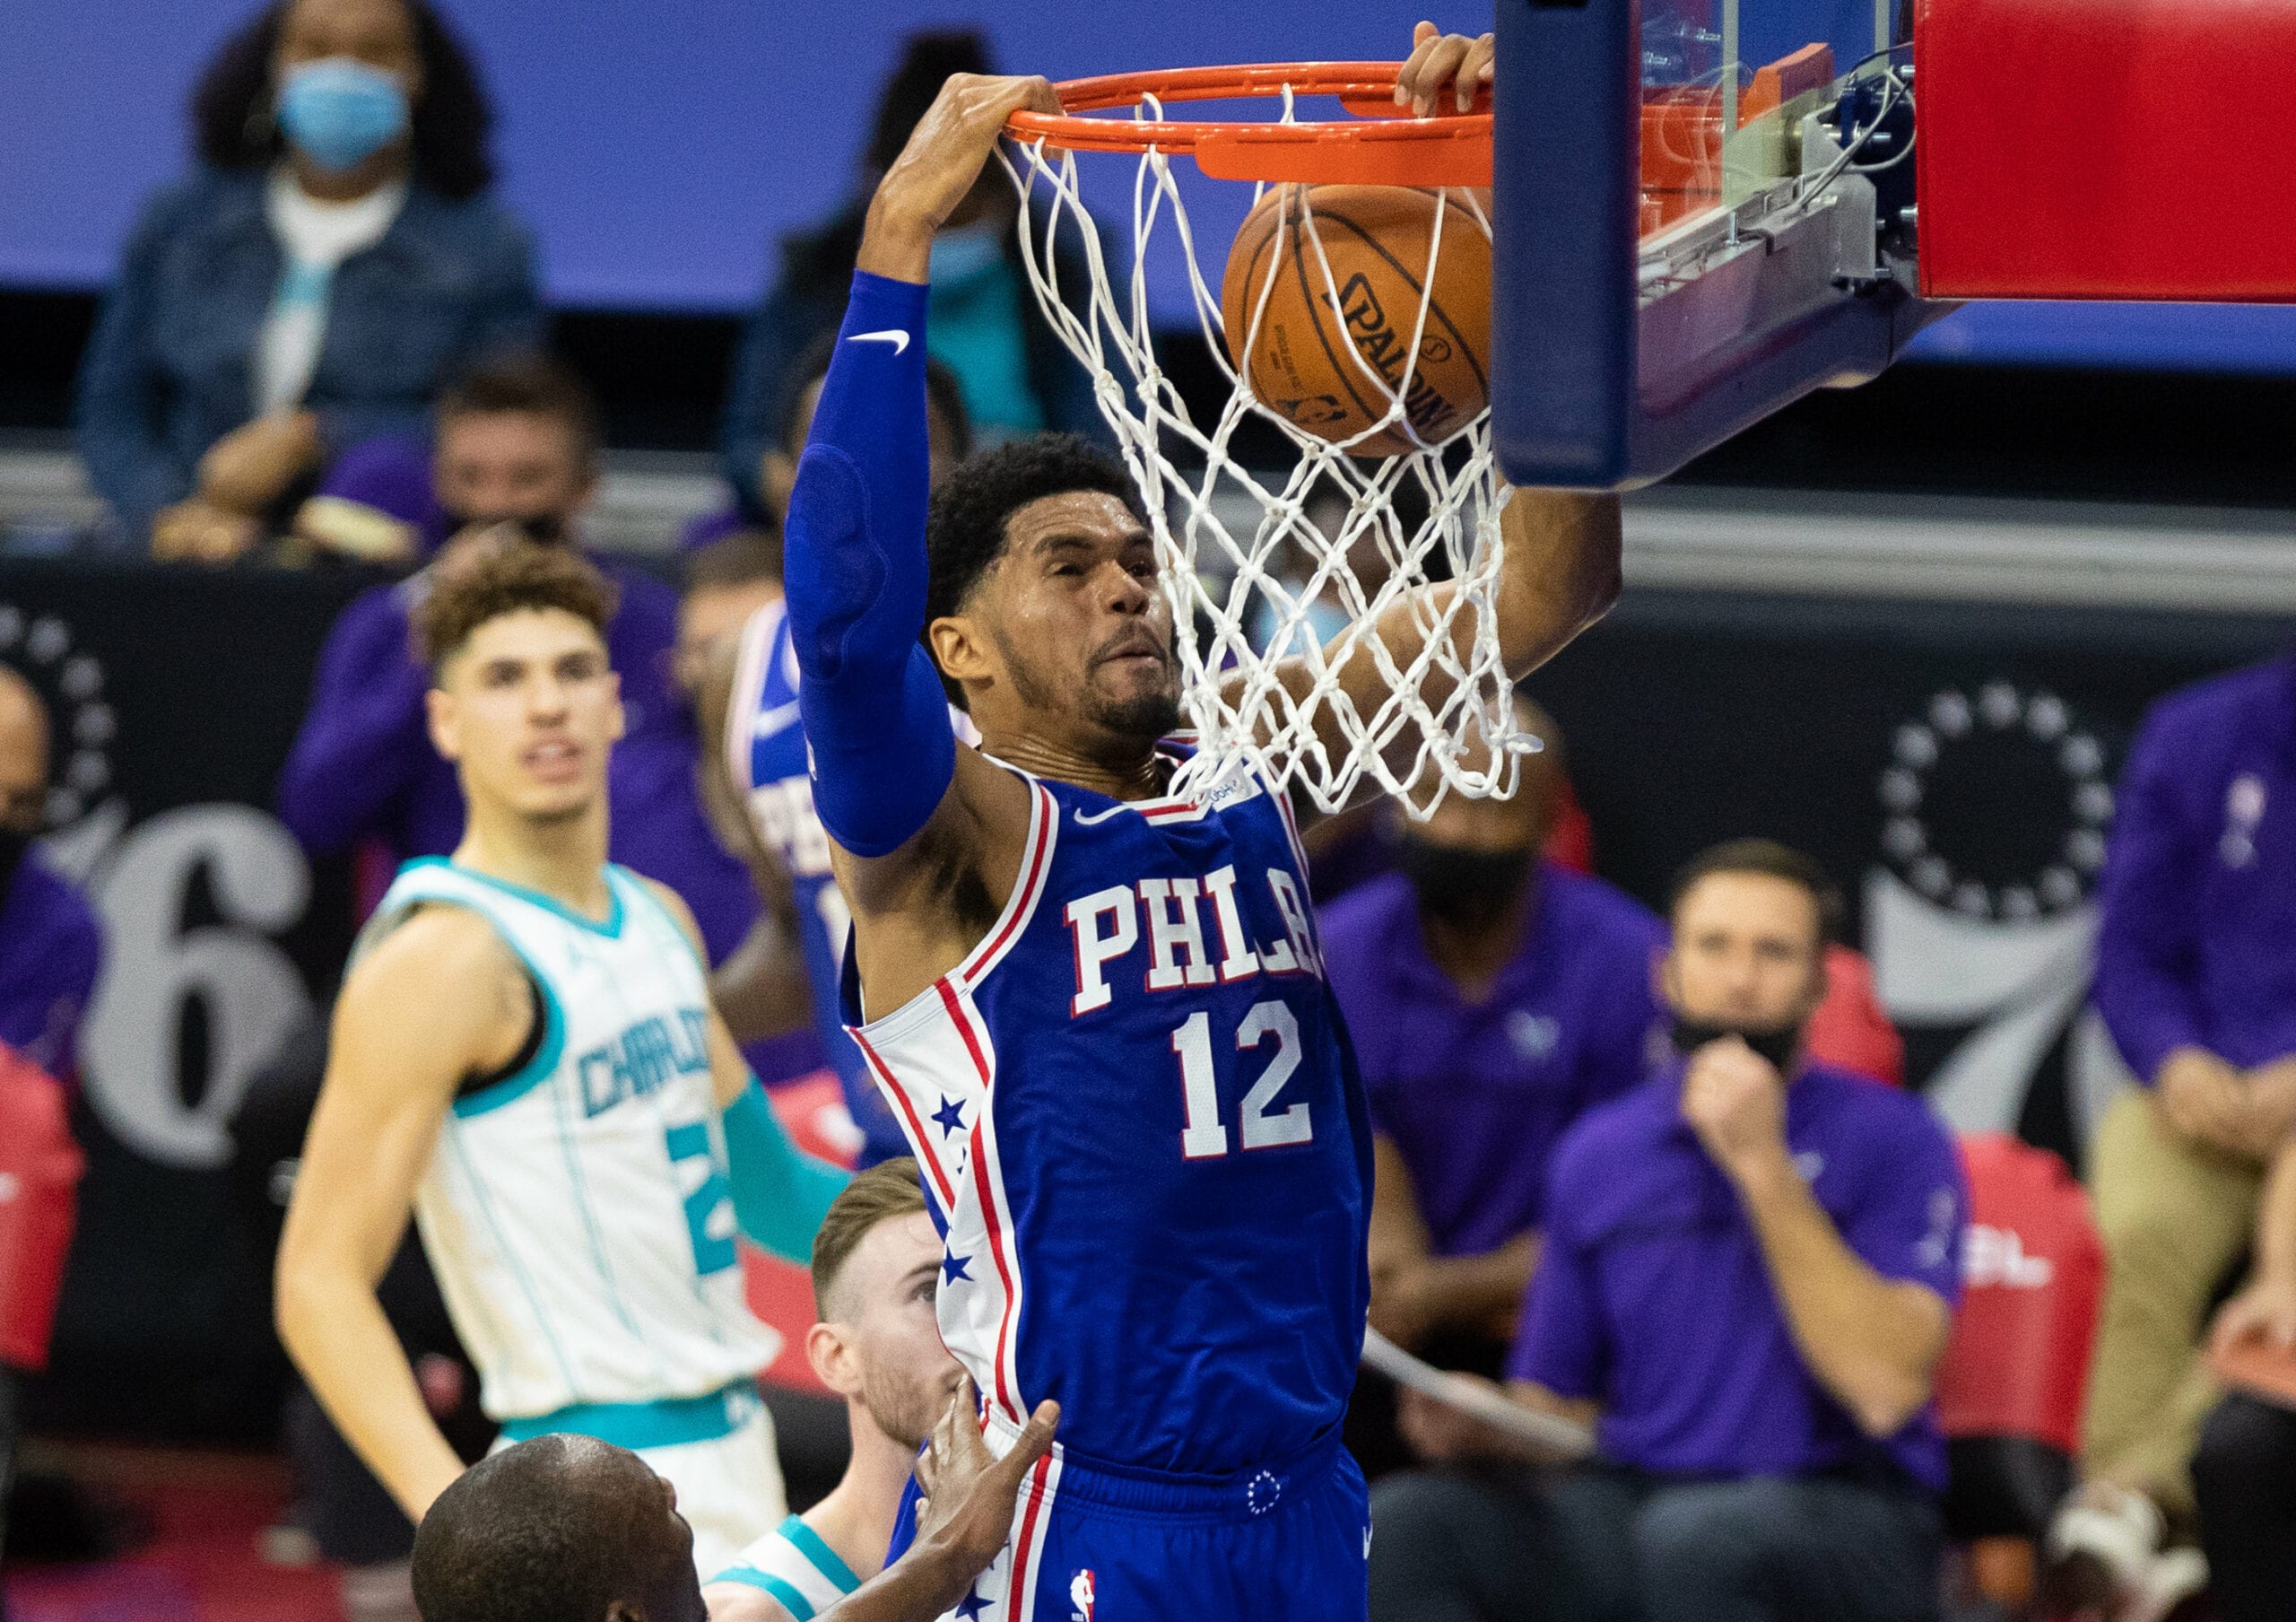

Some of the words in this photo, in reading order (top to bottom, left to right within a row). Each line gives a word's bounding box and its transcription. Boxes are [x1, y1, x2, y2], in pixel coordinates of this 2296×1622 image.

[1321, 271, 1460, 432] SPALDIN
[54, 801, 314, 1168] 6
[1063, 863, 1323, 1019] PHILA
[578, 1007, 710, 1120] CHARLO
[1171, 998, 1313, 1161] 12
